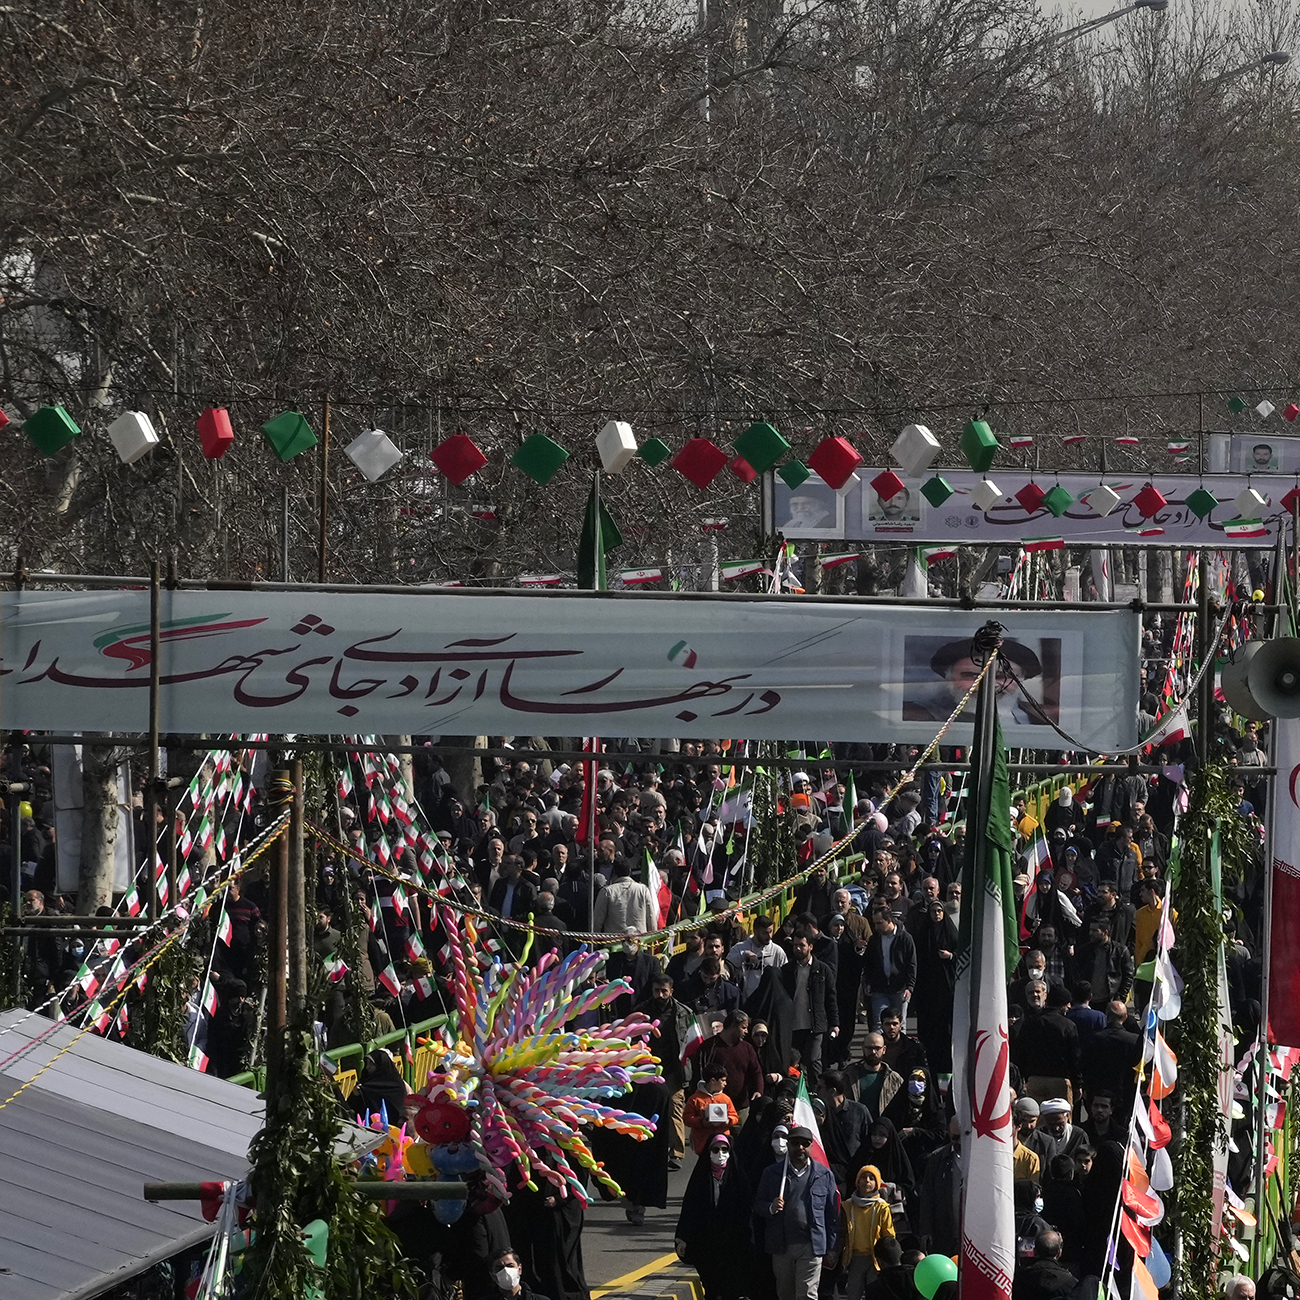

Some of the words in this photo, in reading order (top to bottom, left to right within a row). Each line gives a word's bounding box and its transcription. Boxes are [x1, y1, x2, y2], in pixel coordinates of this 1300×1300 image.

[16, 613, 336, 688] شهدا
[343, 627, 584, 706] آزادی
[233, 655, 388, 717] جای
[500, 659, 753, 722] بهار
[710, 689, 781, 716] در
